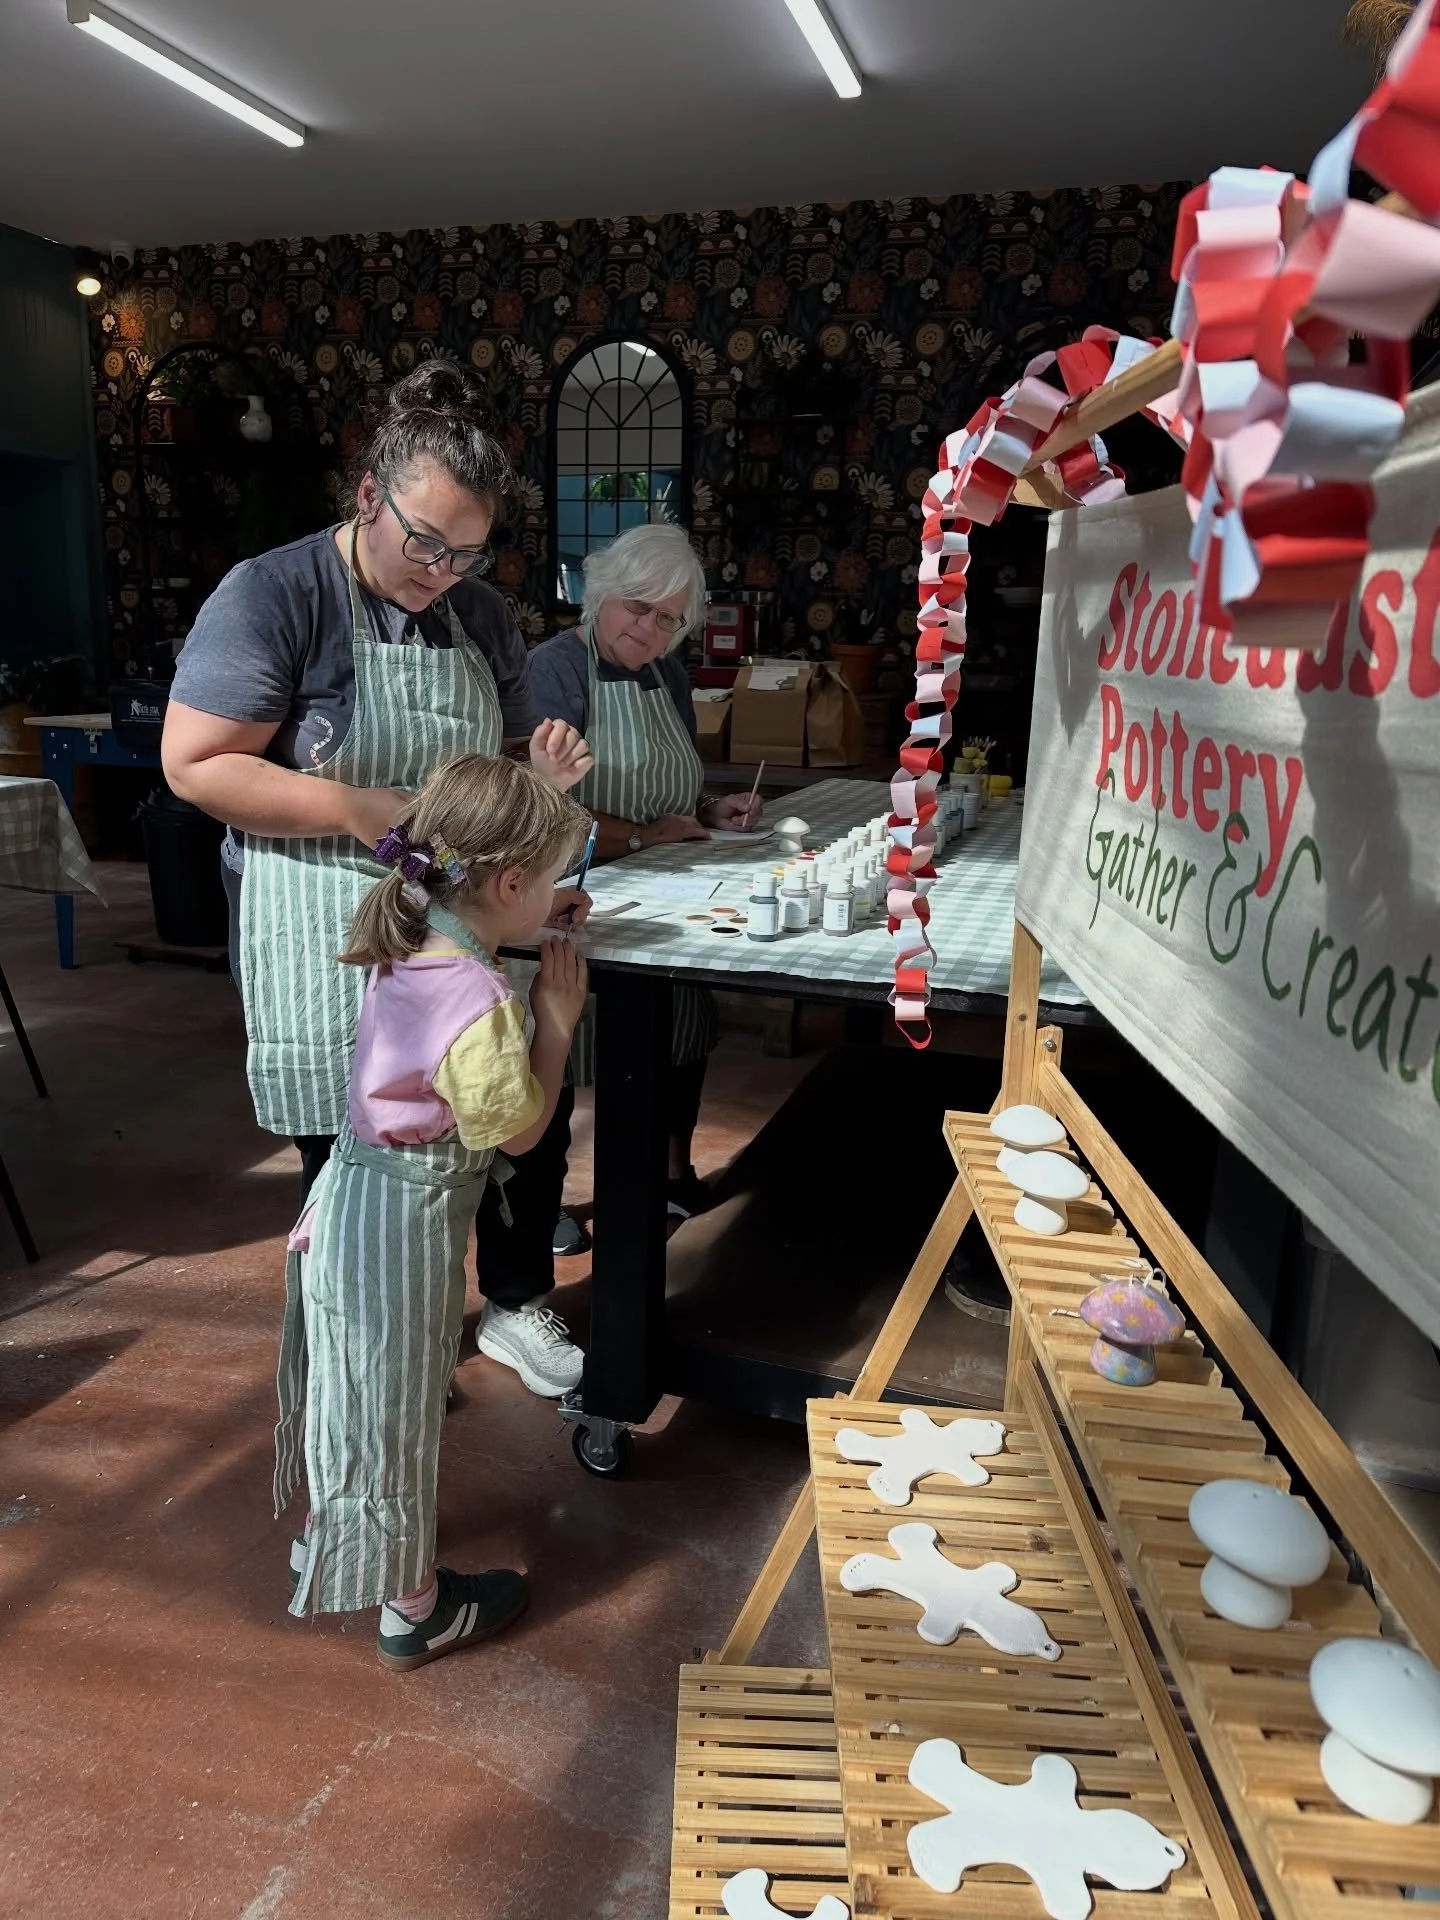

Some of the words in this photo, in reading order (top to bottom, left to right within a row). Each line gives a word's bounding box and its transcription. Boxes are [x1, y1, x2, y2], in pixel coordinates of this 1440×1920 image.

[1096, 684, 1304, 897] Pottery
[1086, 768, 1198, 931] Gather
[1205, 811, 1263, 964] &
[1262, 835, 1440, 1105] Creat
